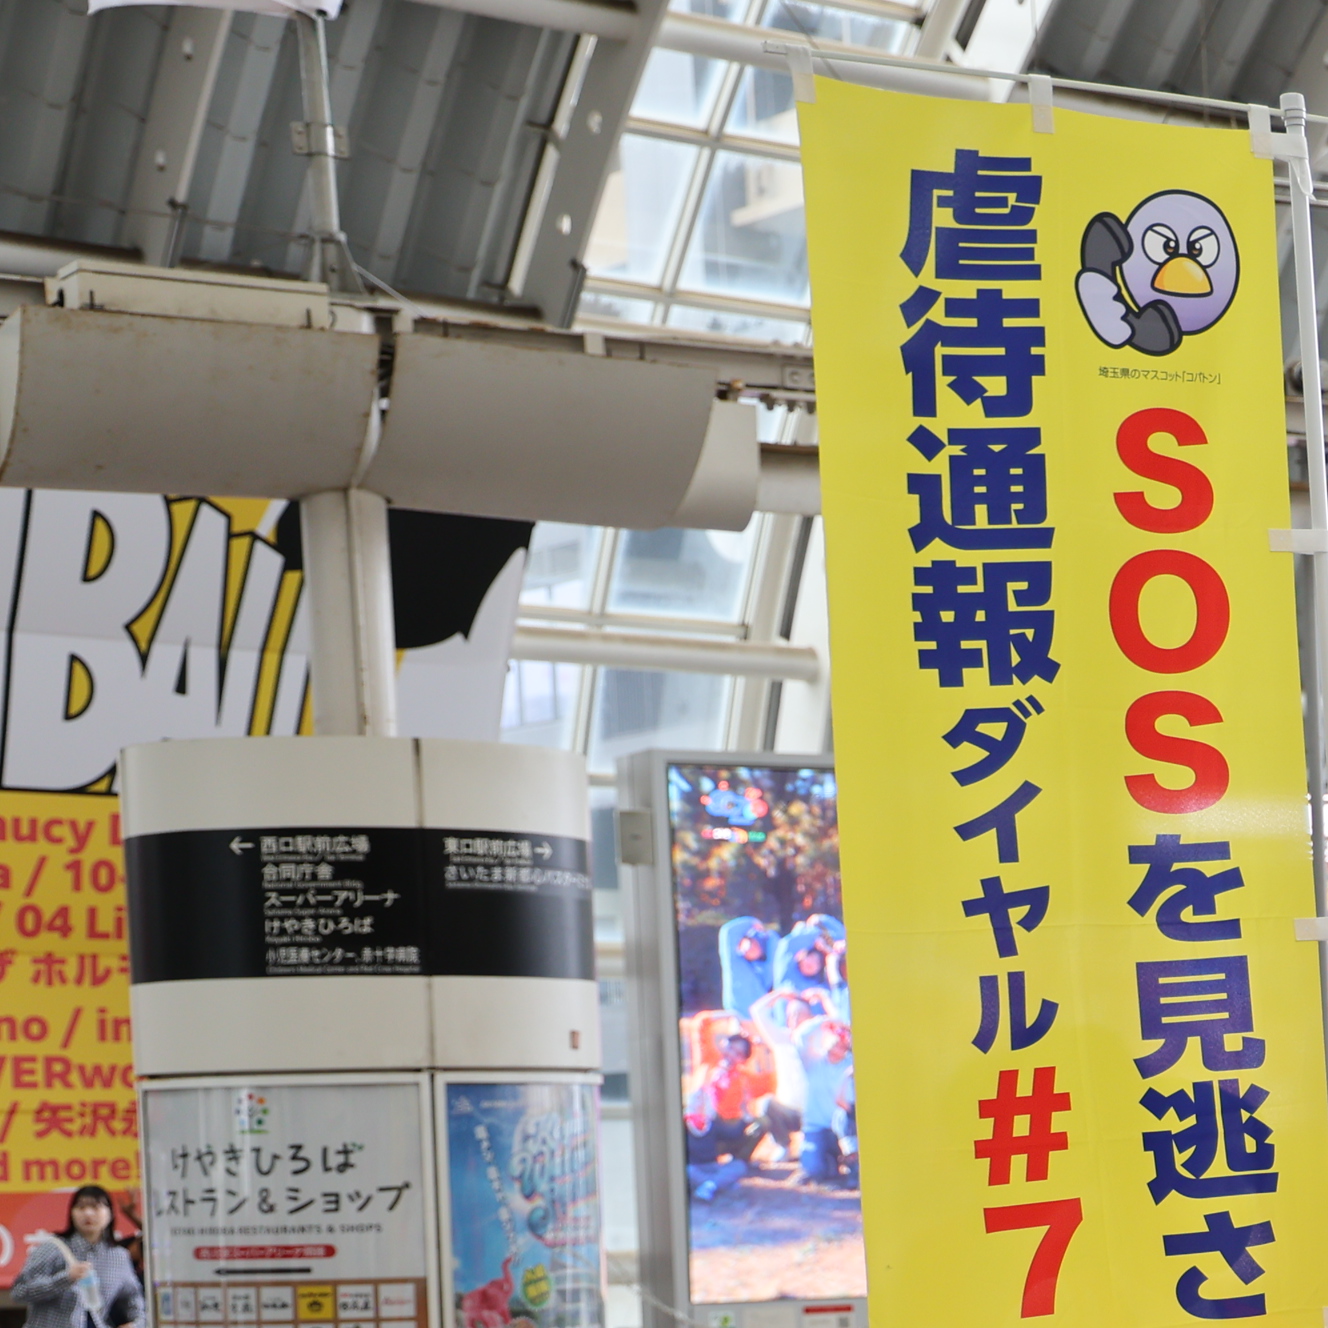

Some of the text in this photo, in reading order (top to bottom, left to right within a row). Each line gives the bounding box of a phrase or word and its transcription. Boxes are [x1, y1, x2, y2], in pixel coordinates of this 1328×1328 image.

[63, 858, 126, 894] 10
[264, 888, 401, 908] スーパーアリーナ
[15, 903, 127, 940] 04 Li
[264, 915, 375, 936] けやきひろば
[31, 951, 130, 988] ホル
[171, 1142, 365, 1179] けやきひろば
